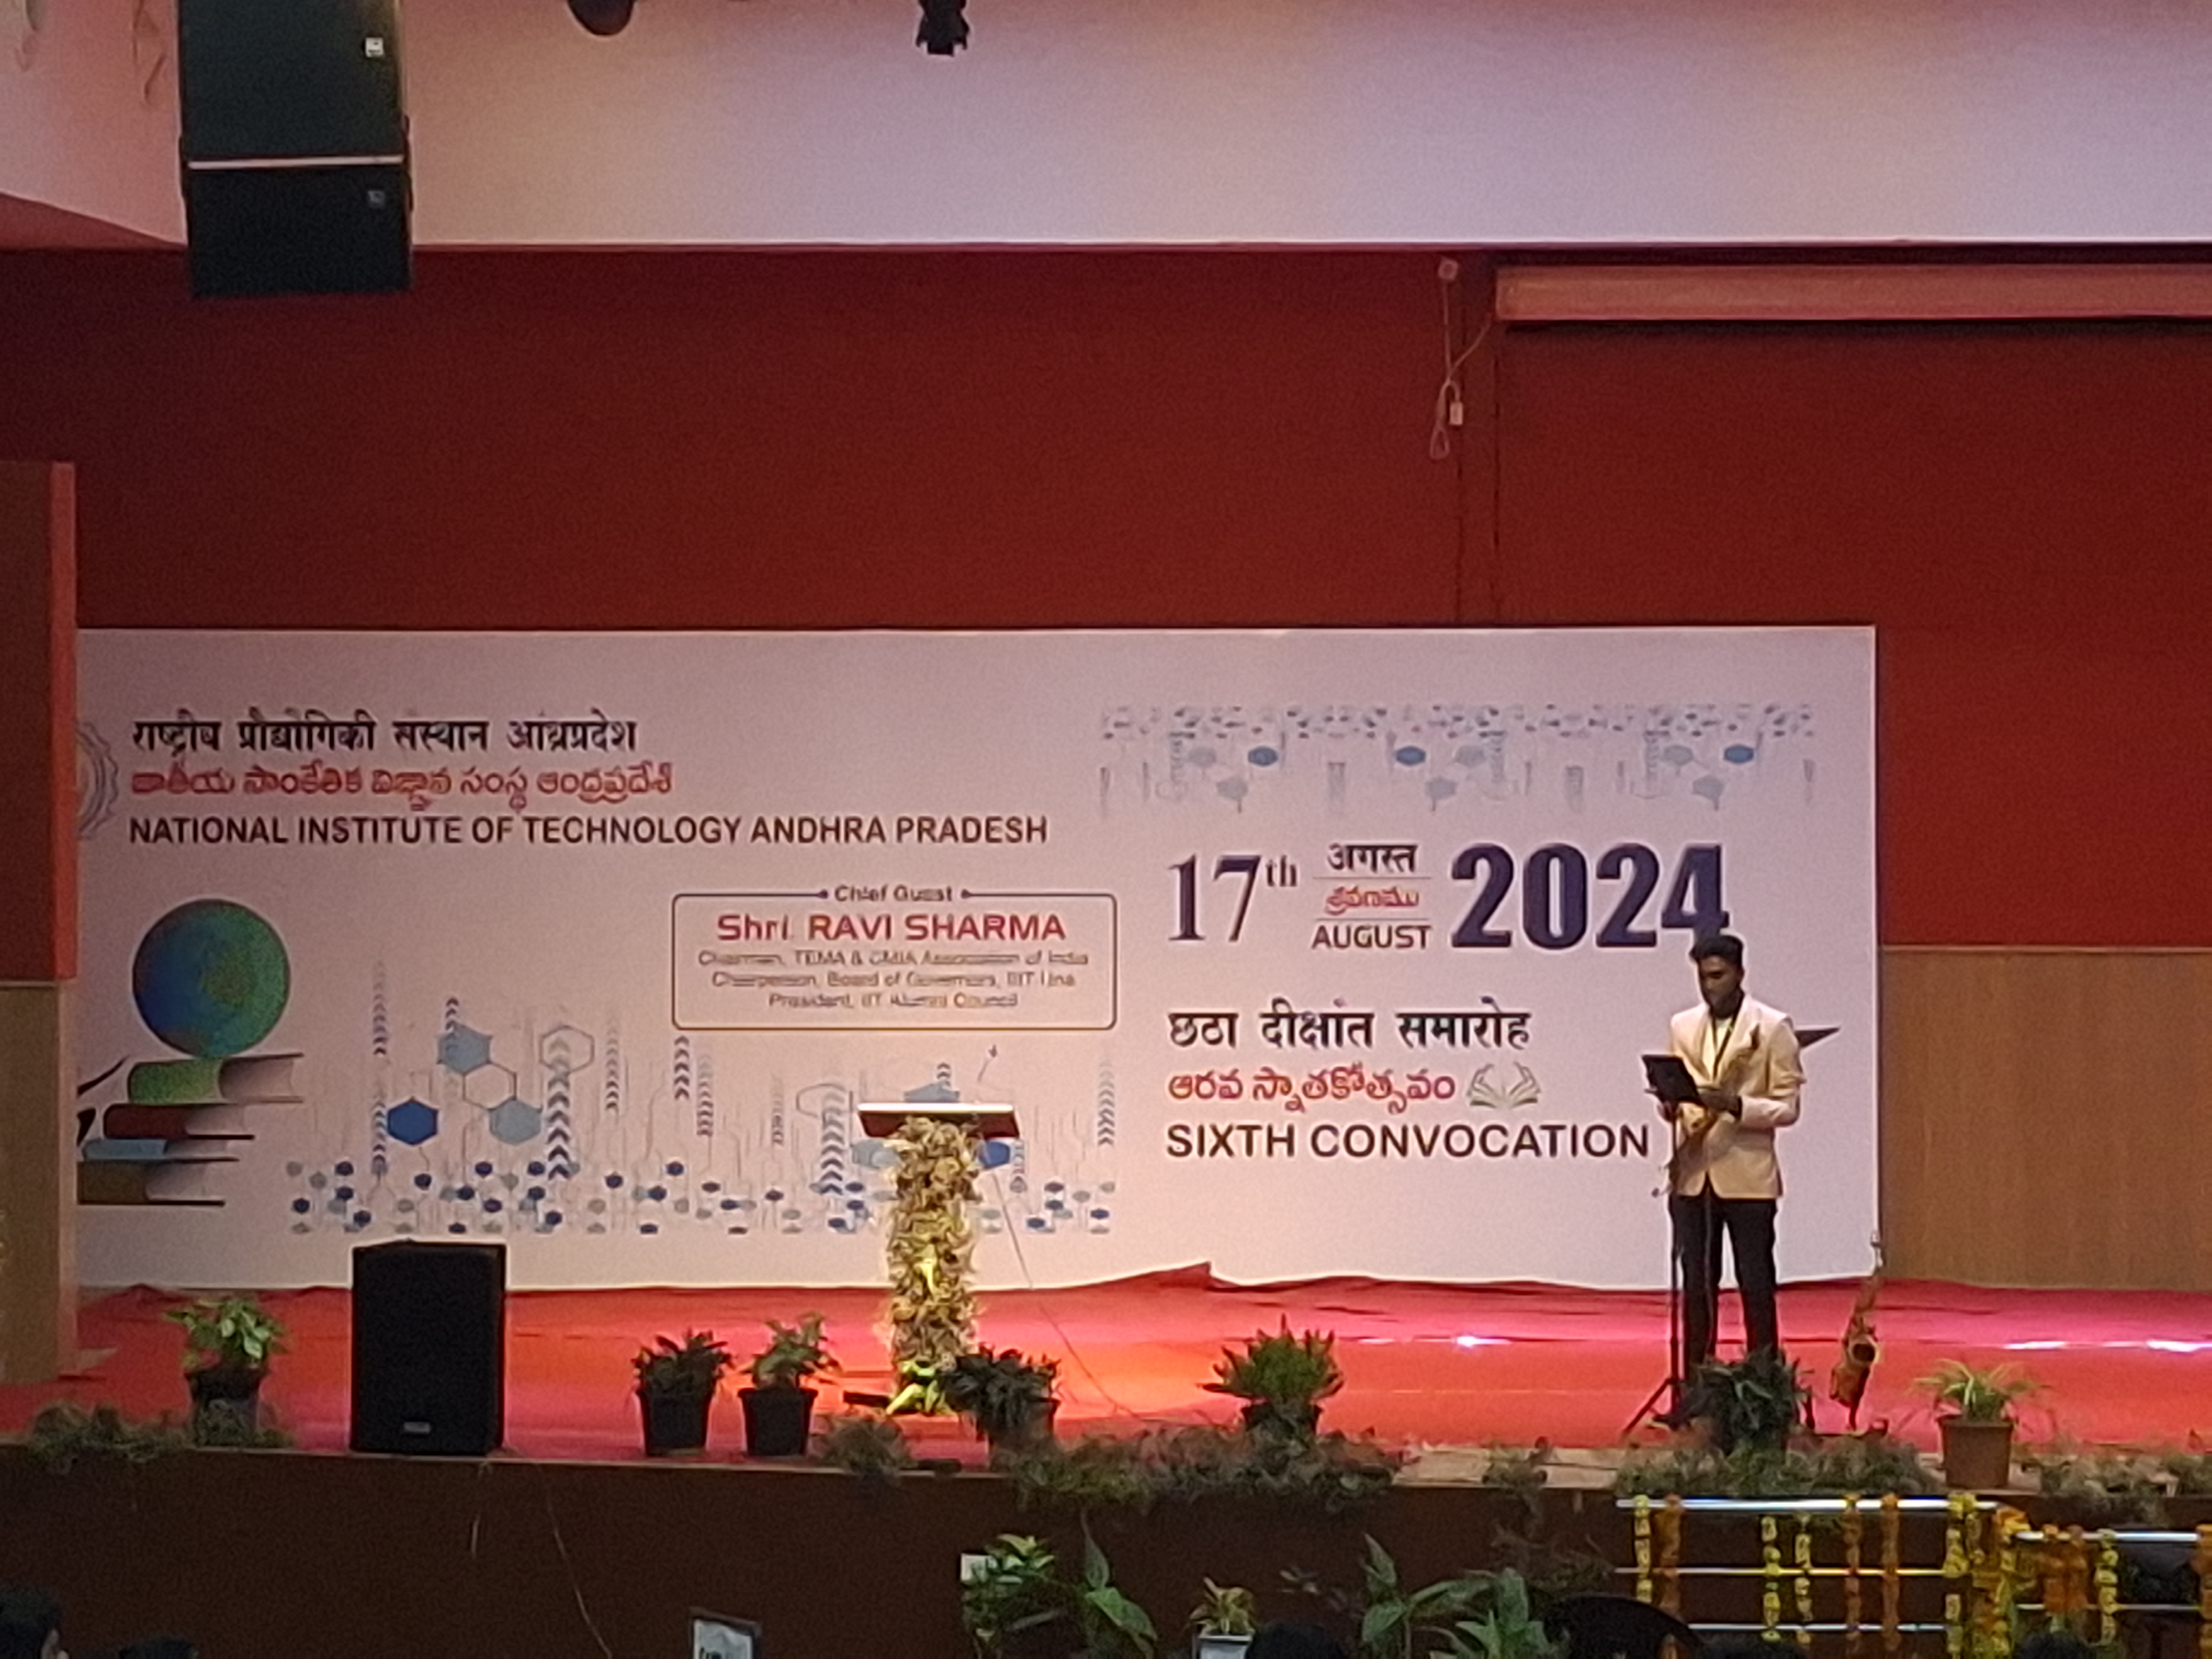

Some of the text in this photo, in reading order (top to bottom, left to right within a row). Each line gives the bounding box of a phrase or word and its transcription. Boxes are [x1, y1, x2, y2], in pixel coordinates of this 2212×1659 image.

[130, 816, 1047, 844] NATIONAL INSTITUTE OF TECHNOLOGY ANDHRA PRADESH
[1328, 843, 1418, 872] अगस्त
[834, 884, 888, 902] Chief
[1169, 854, 1297, 942] 17th
[1451, 843, 1729, 949] 2024
[809, 914, 891, 941] RAVI
[905, 914, 1066, 941] SHARMA
[1311, 925, 1432, 949] AUGUST
[1167, 996, 1532, 1050] छठा दीक्षांत समारोह
[1168, 1069, 1243, 1099] ఆరవ
[1167, 1124, 1649, 1158] SIXTH CONVOCATION
